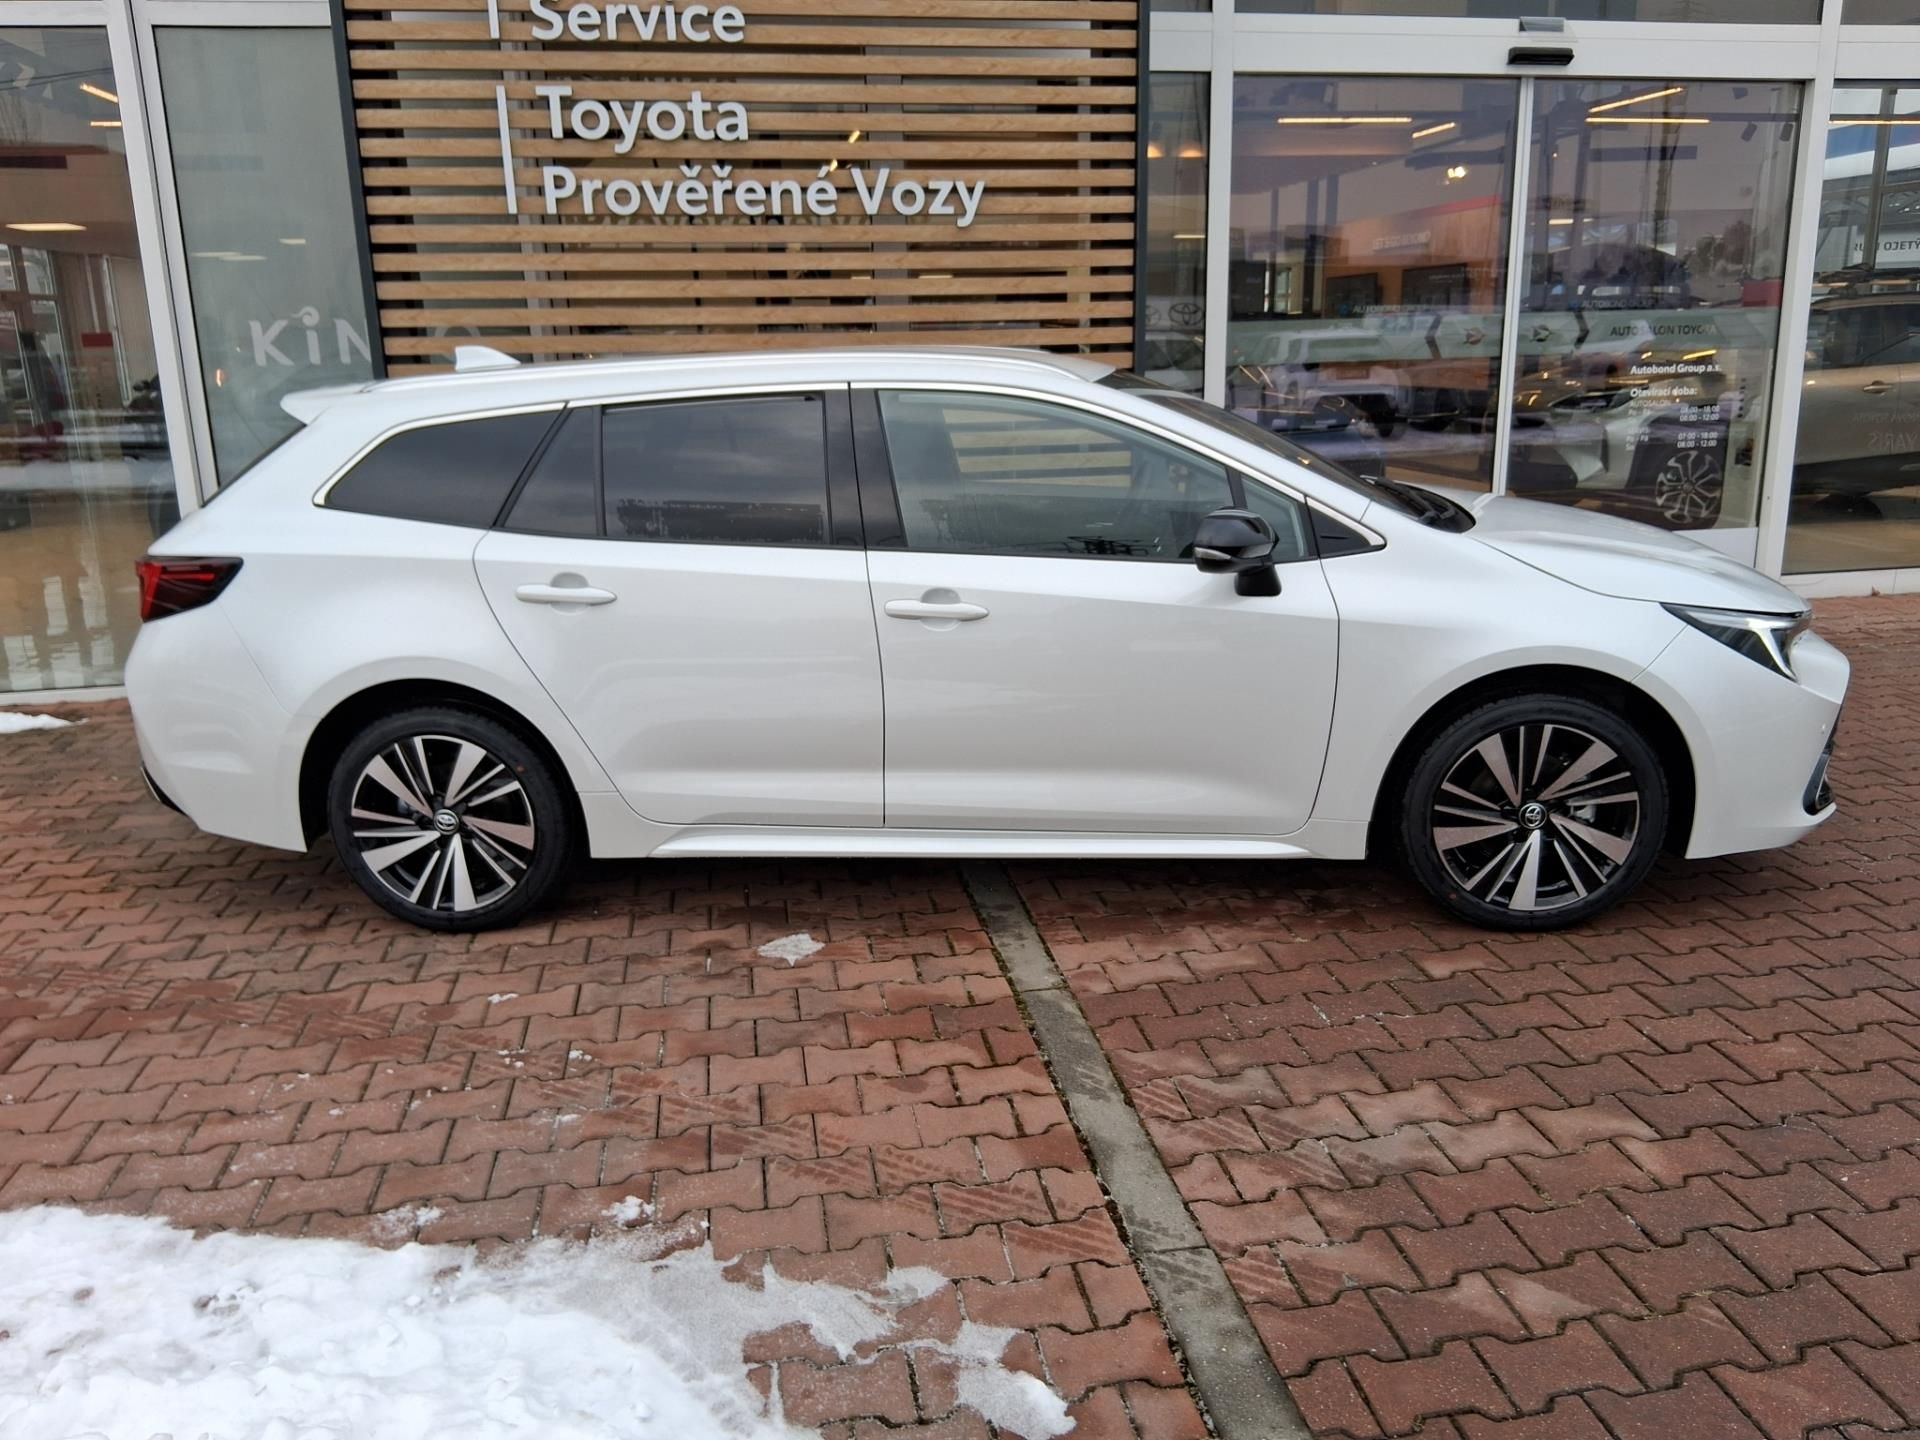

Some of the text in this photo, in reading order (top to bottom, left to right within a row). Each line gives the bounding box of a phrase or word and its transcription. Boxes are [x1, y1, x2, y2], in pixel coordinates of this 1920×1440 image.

[530, 0, 746, 43] Service
[535, 85, 749, 153] Toyota
[542, 163, 986, 228] Prověřené Vozy
[1630, 363, 1676, 375] Autobond
[1677, 362, 1705, 374] Group
